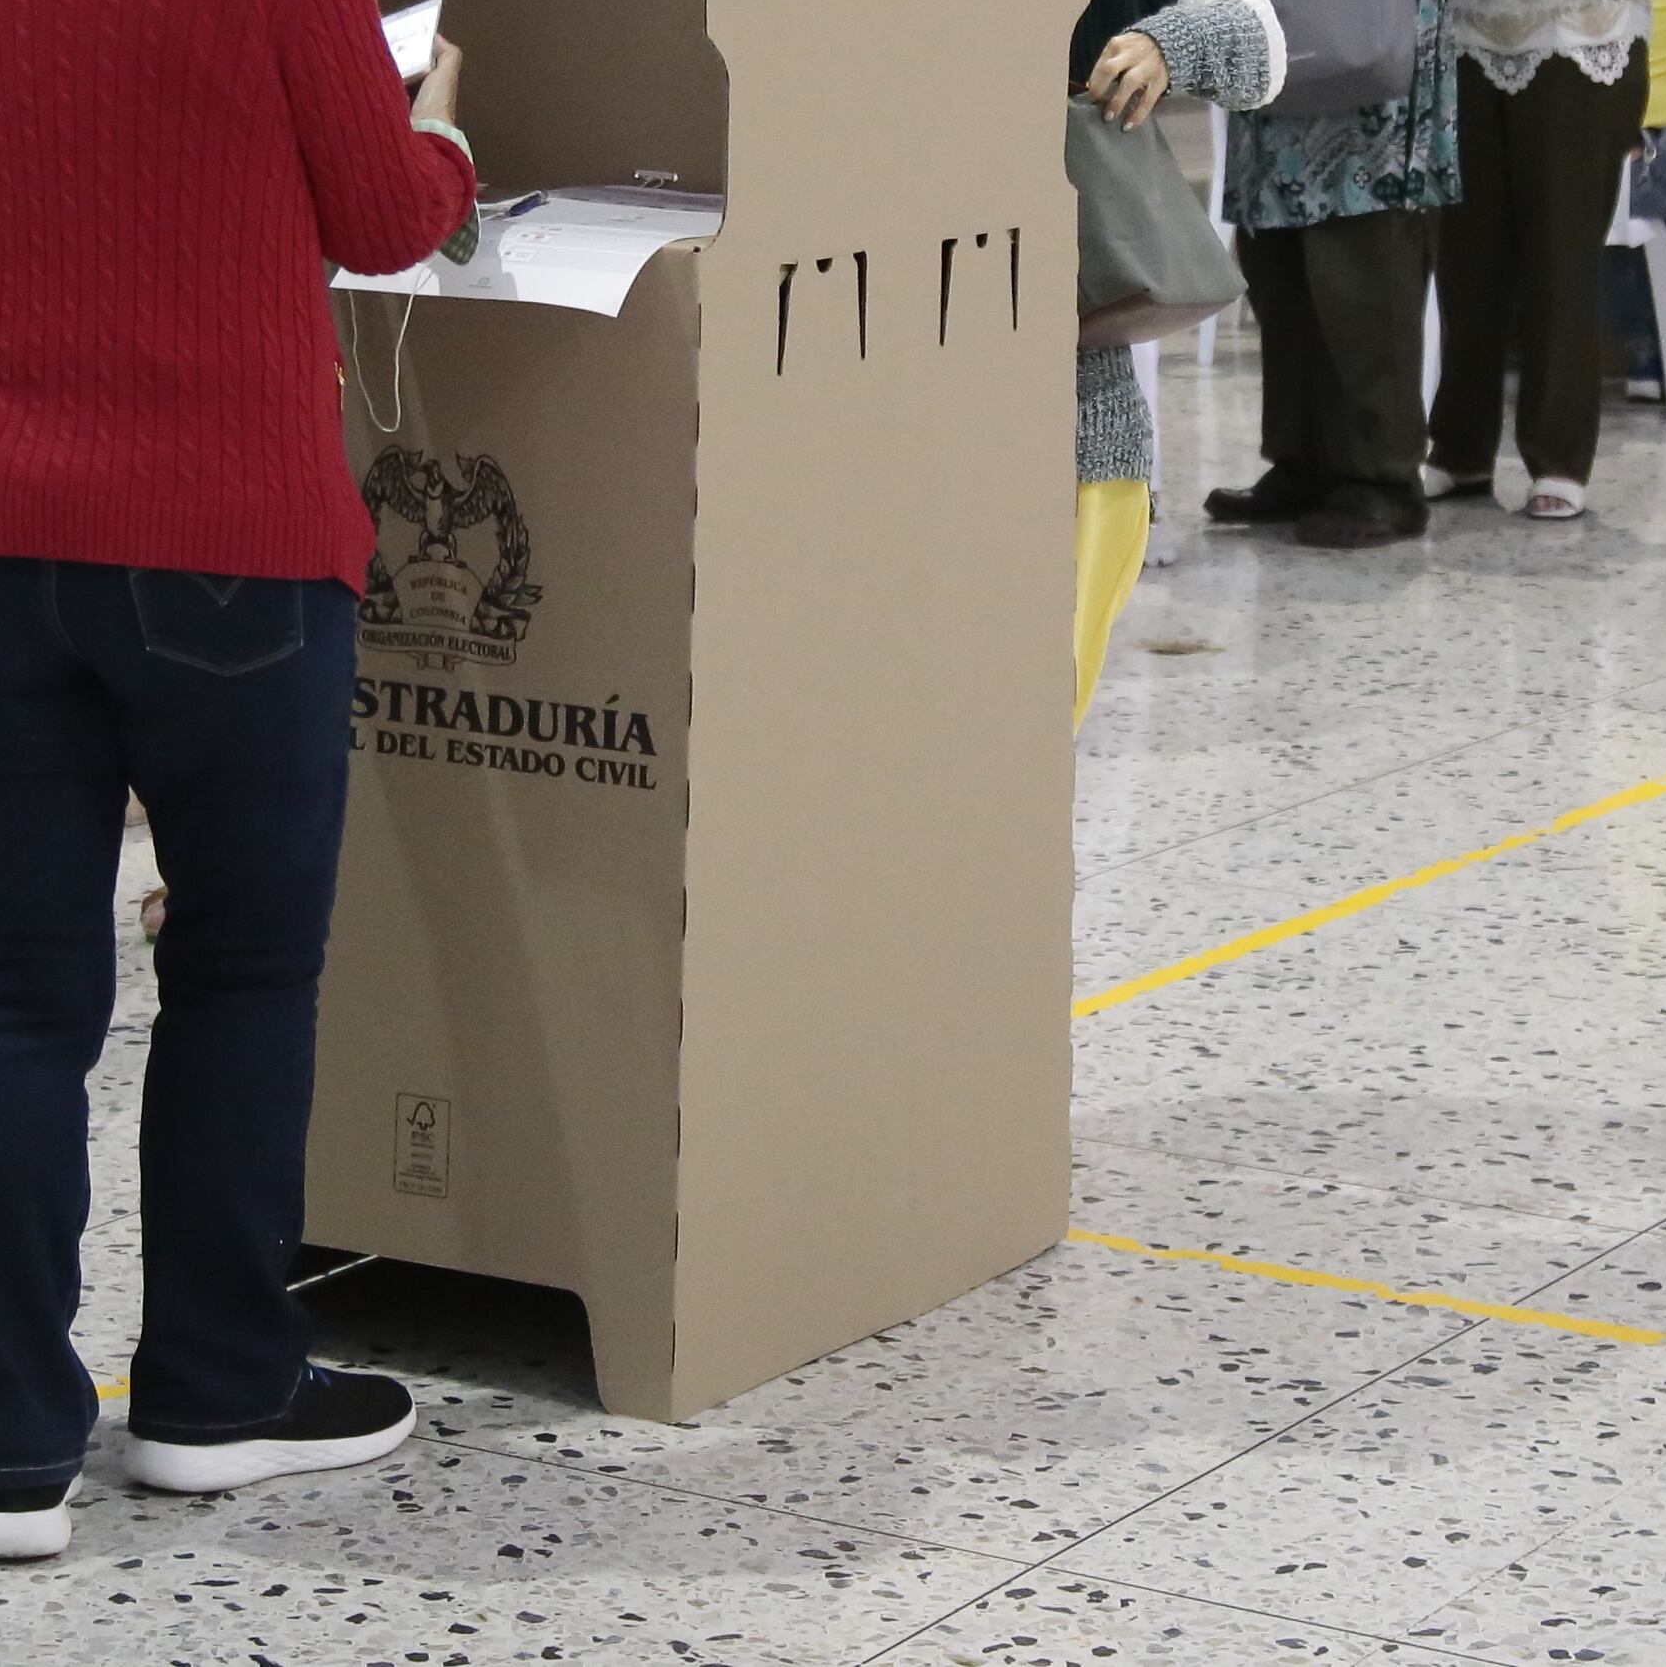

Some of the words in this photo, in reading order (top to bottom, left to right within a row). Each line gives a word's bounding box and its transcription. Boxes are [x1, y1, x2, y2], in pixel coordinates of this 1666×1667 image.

[431, 591, 446, 602] DE
[410, 606, 466, 625] COLOMBIA
[361, 629, 445, 648] ORGANIZACIÓN
[447, 636, 511, 660] ELECTORAL
[376, 730, 436, 761] DEL
[446, 739, 566, 777] ESTADO
[576, 757, 657, 790] CIVIL
